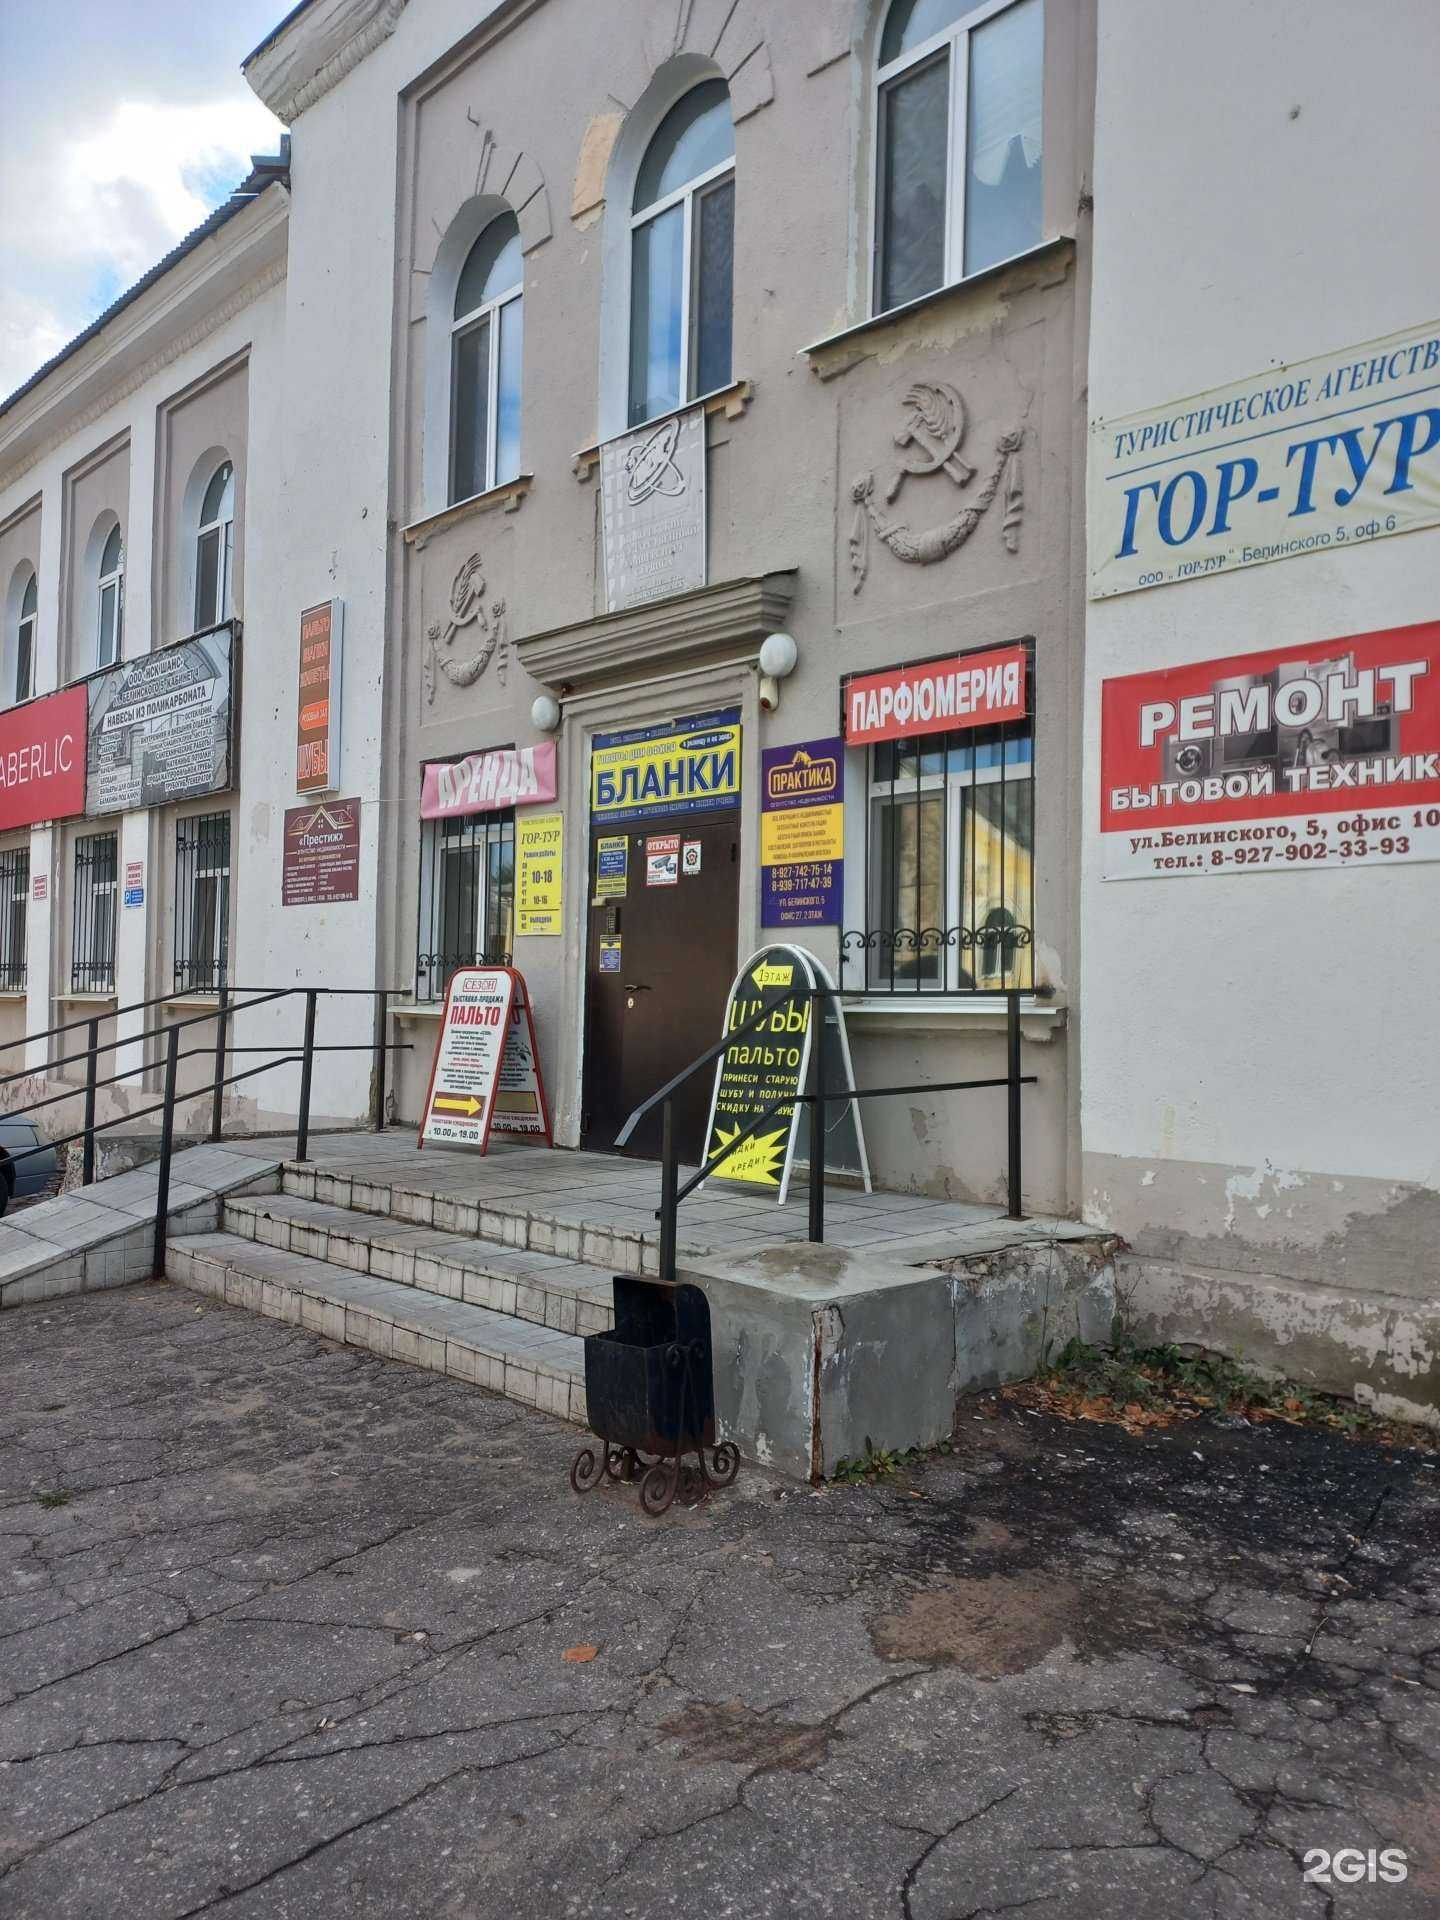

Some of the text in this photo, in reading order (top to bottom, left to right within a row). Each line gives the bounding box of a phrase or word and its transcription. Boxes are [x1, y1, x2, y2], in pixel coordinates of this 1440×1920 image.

[1115, 379, 1311, 459] ТУРИСТИЧЕСКОЕ
[1115, 408, 1440, 559] ГОР-ТУР
[1355, 519, 1380, 540] оф
[1386, 514, 1397, 531] 6
[107, 686, 205, 727] НАВЕСЫ ИЗ ПОЛИКАРБОНАТА
[851, 661, 1020, 732] ПАРФЮМЕРИЯ
[1139, 658, 1430, 748] РЕМОНТ
[438, 747, 539, 809] АРЕНДА
[596, 749, 736, 806] БЛАНКИ
[772, 766, 832, 792] ПРАКТИКА
[1110, 753, 1440, 811] БЫТОВОЙ ТЕХНИК
[521, 830, 560, 845] ГОР-ТУР
[1130, 809, 1440, 854] ул.Белинского, 5, офис 10
[647, 839, 679, 851] ОТКРЫТО
[1211, 836, 1410, 867] 8-927-902-33-93
[532, 869, 553, 884] 10-18
[465, 979, 496, 991] СЕЗОН
[450, 1005, 501, 1026] ПАЛЬТО
[723, 1073, 799, 1085] ПРИНЕСИ СТАРУЮ
[720, 1089, 744, 1098] ШУБУ
[748, 1089, 755, 1098] И
[716, 1102, 750, 1114] СКИДКУ
[754, 1105, 765, 1113] НА
[434, 1127, 451, 1137] 10.00
[459, 1129, 479, 1139] 19.00
[731, 1156, 767, 1174] КРЕДИТ
